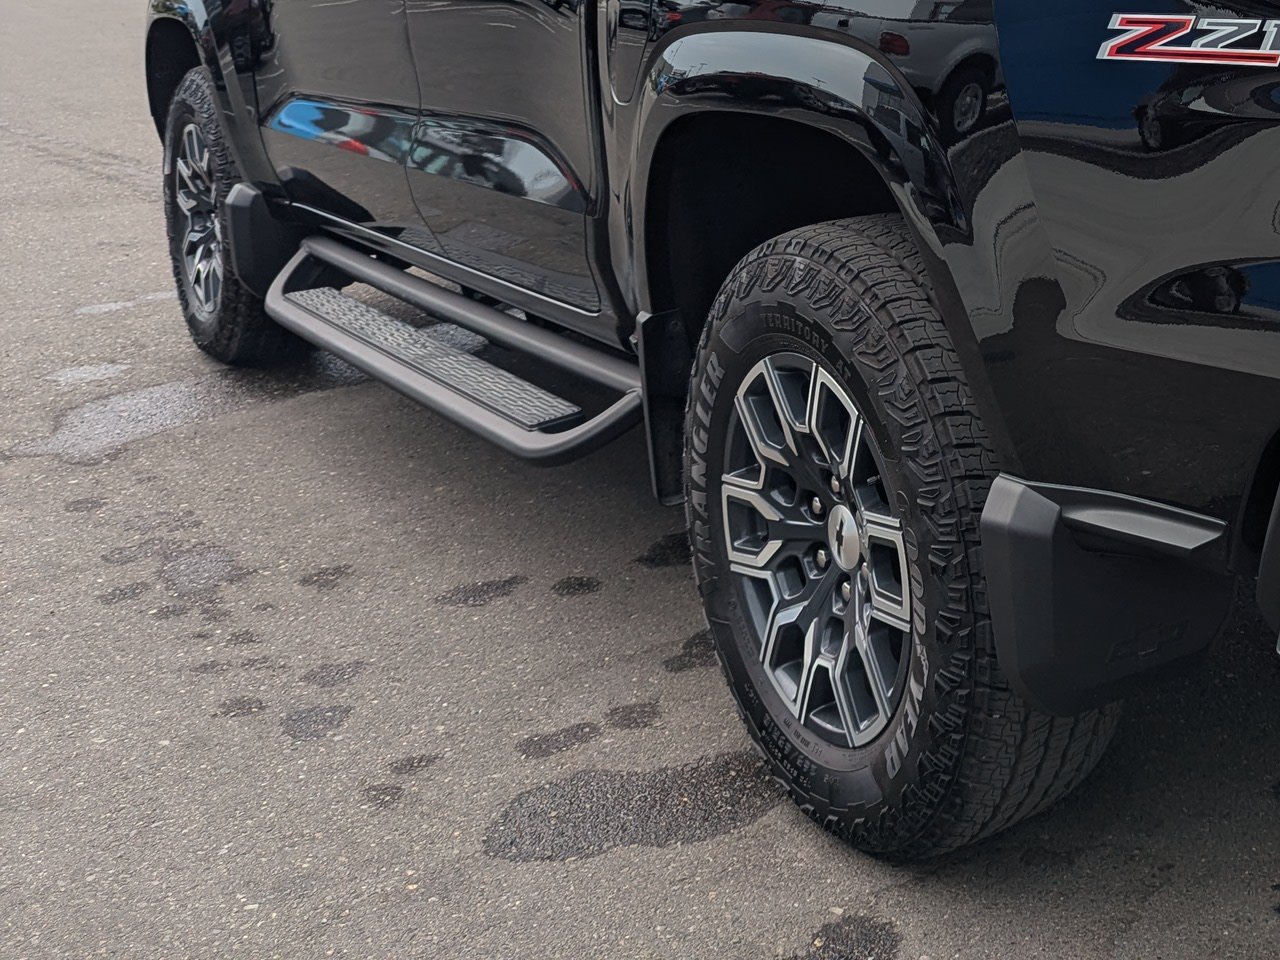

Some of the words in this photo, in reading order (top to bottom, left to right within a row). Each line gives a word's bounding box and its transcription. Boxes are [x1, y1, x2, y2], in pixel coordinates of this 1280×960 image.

[760, 312, 828, 354] TERRITORY
[691, 350, 727, 588] WRANGLER
[885, 490, 930, 780] GOODYEAR
